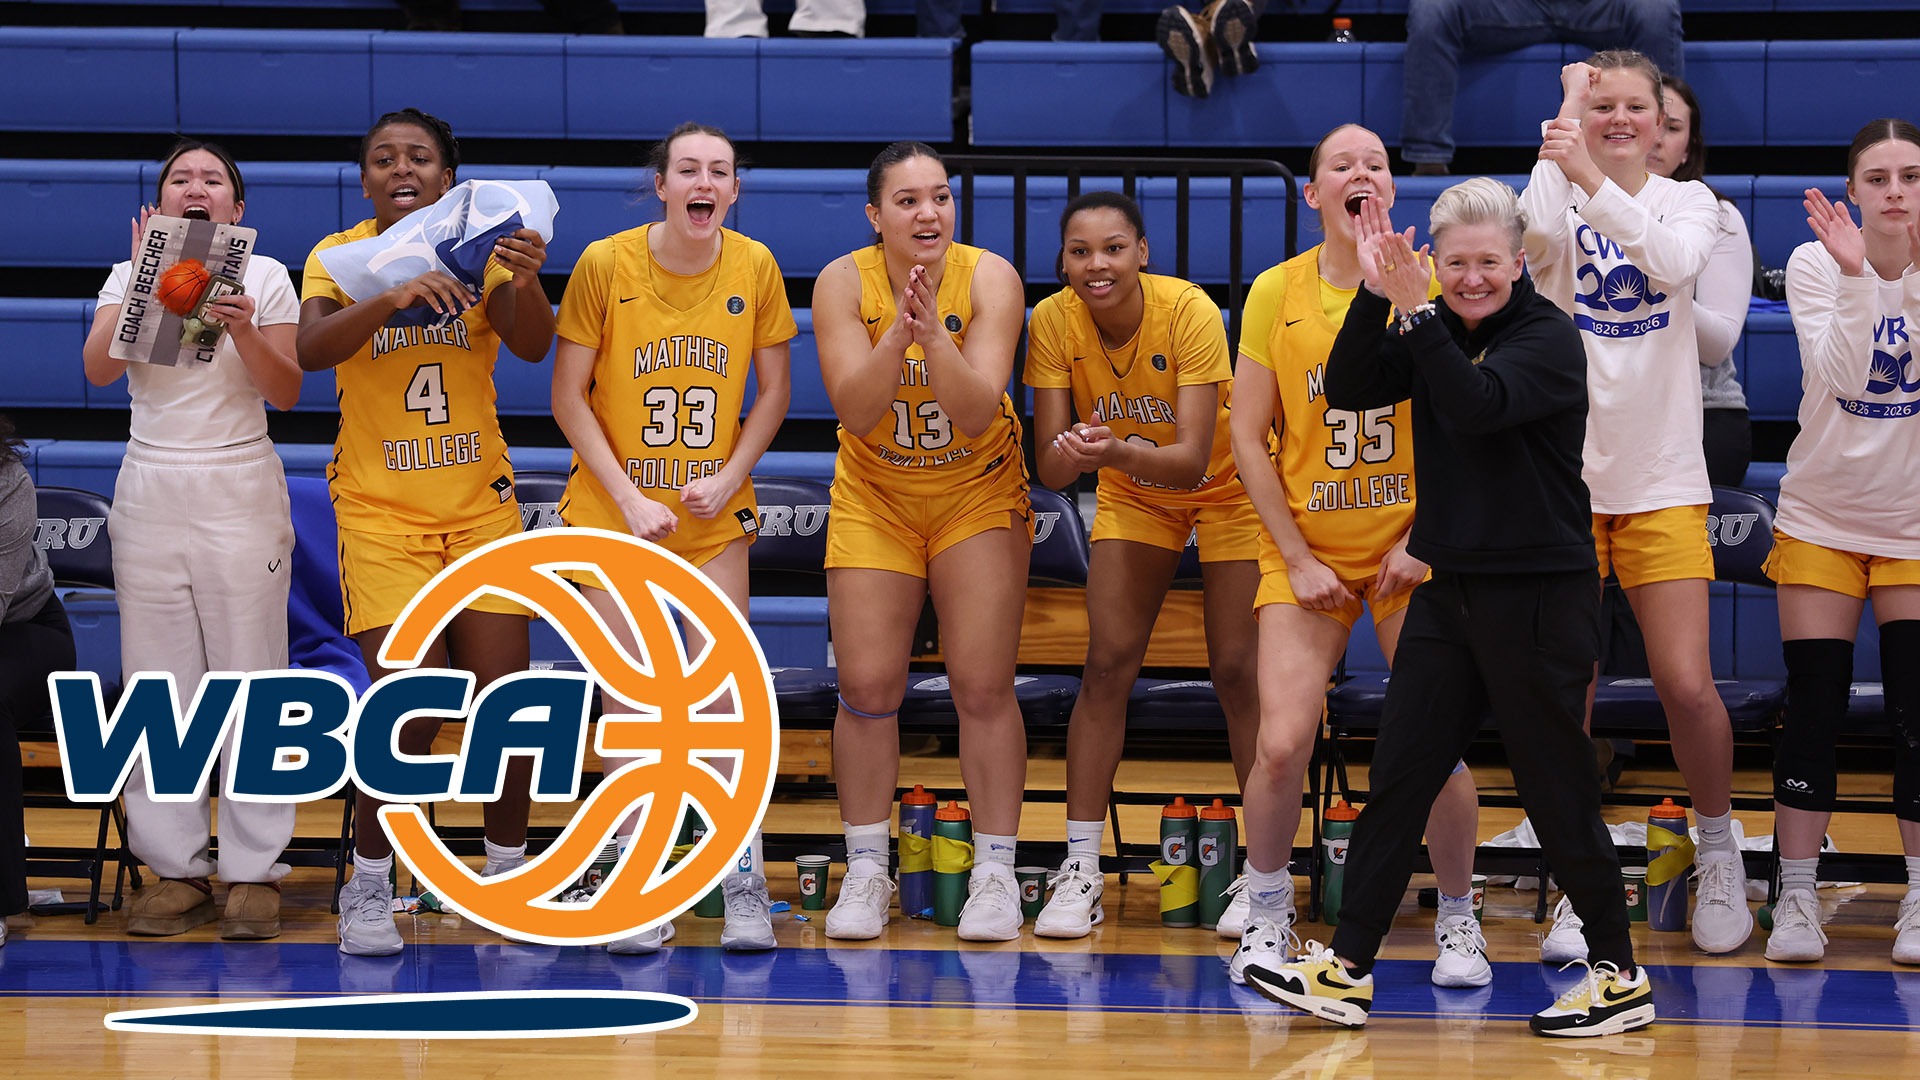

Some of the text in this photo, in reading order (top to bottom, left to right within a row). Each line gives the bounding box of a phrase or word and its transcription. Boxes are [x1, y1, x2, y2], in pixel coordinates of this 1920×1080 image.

[119, 229, 169, 344] COACH BEECHER
[1591, 321, 1620, 336] 1826
[1632, 316, 1660, 334] 2026
[634, 335, 728, 379] MATHER
[404, 362, 450, 426] 4
[1092, 391, 1177, 424] MAHER
[1844, 401, 1870, 416] 1826
[1883, 404, 1912, 417] 2026
[641, 386, 717, 449] 33
[891, 399, 954, 450] 13
[1323, 404, 1395, 469] 35
[382, 430, 482, 471] COLLEGE
[1307, 474, 1410, 512] COLLEGE
[33, 518, 105, 550] RU
[757, 505, 831, 536] RU
